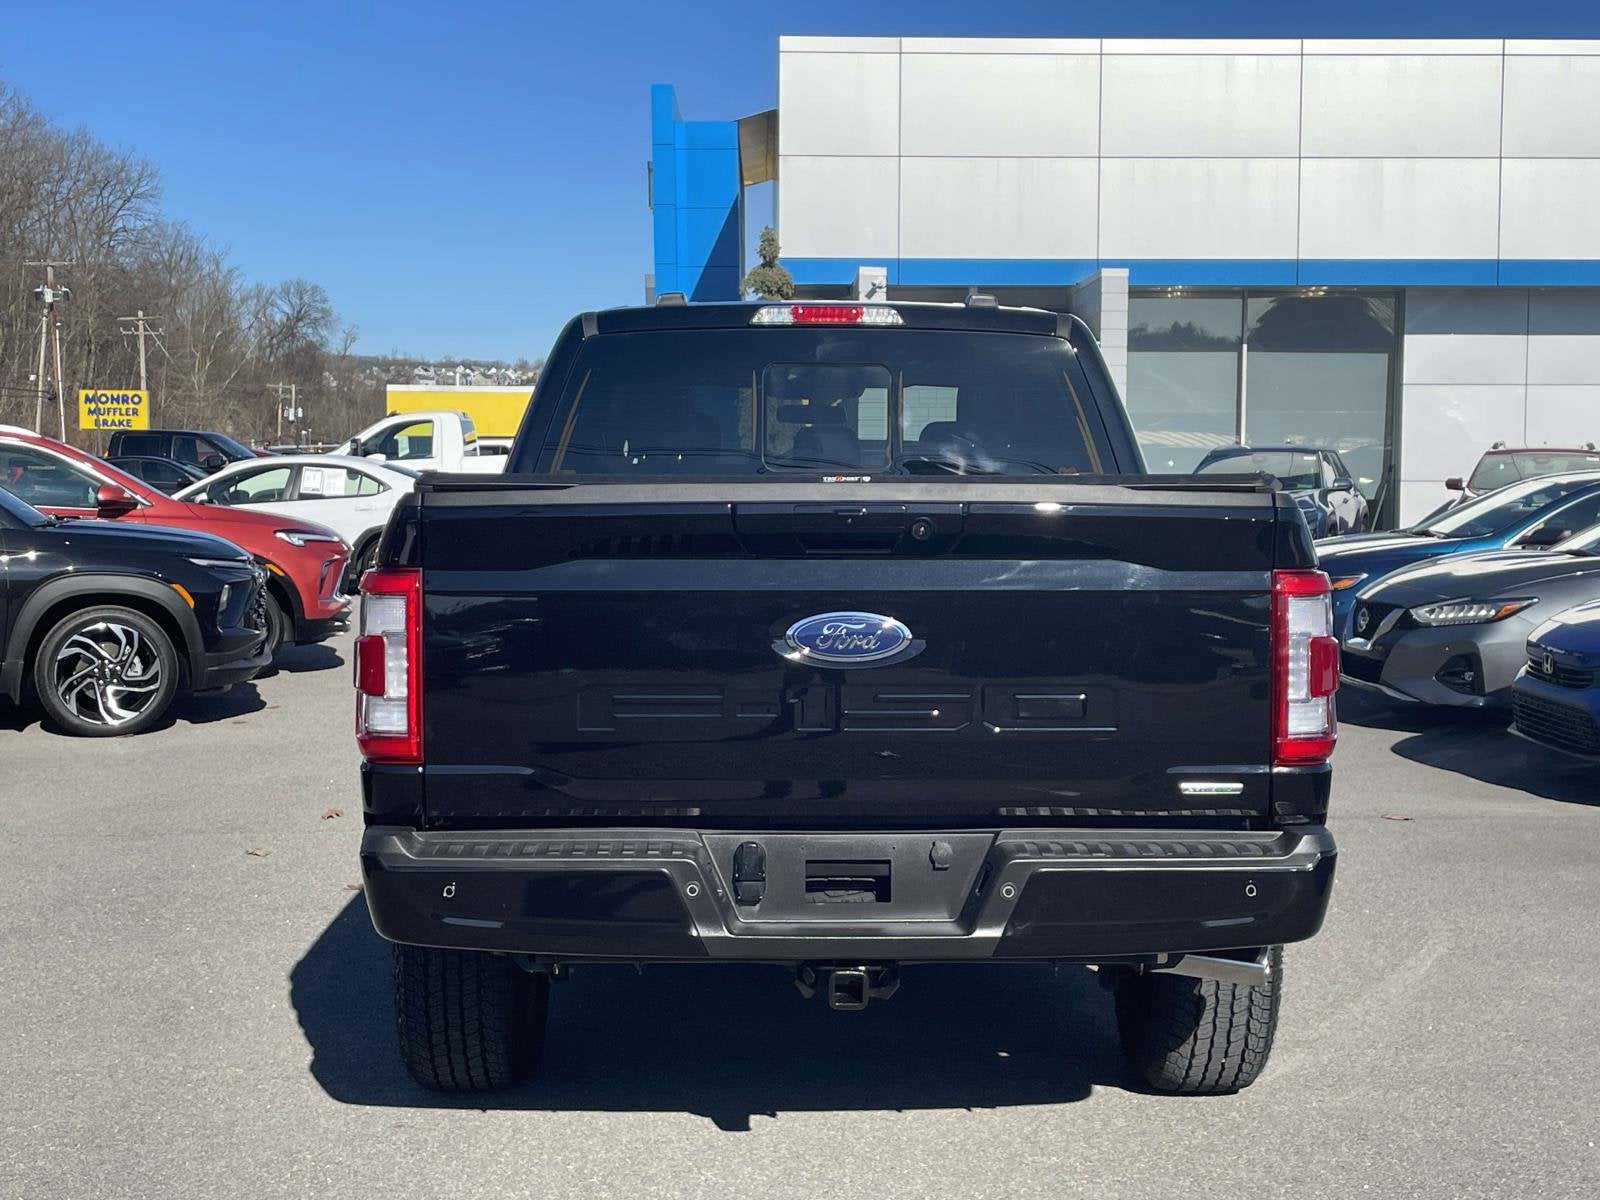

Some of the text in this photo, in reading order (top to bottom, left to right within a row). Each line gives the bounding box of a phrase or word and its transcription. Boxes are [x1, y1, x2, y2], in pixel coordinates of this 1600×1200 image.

[84, 393, 142, 405] MONRO
[88, 407, 139, 416] MUFFLER
[816, 622, 883, 650] Ford
